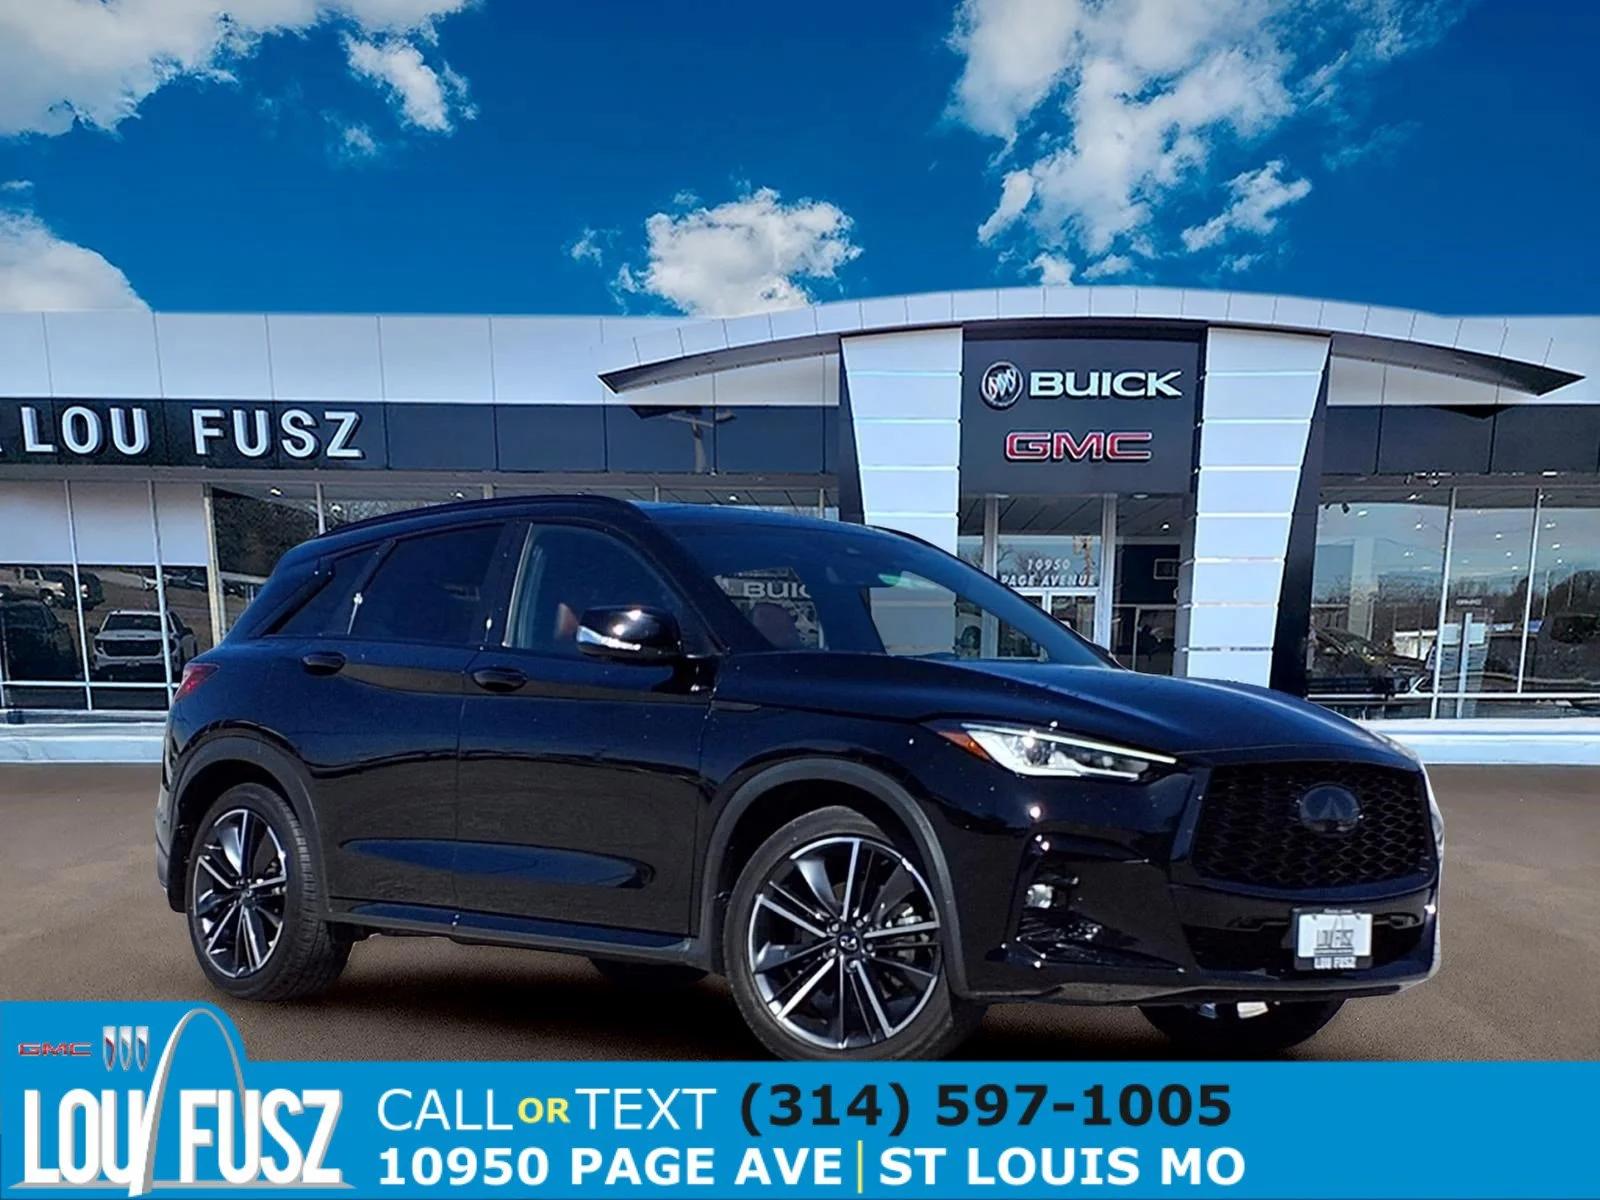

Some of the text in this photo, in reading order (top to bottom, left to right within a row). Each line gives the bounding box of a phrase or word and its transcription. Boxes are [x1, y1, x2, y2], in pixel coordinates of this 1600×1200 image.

[1029, 371, 1183, 397] BUICK
[21, 406, 363, 457] LOU FUSZ
[1006, 431, 1153, 460] GMC
[1028, 559, 1071, 571] 10950
[1001, 574, 1096, 586] PAGE AVENUE
